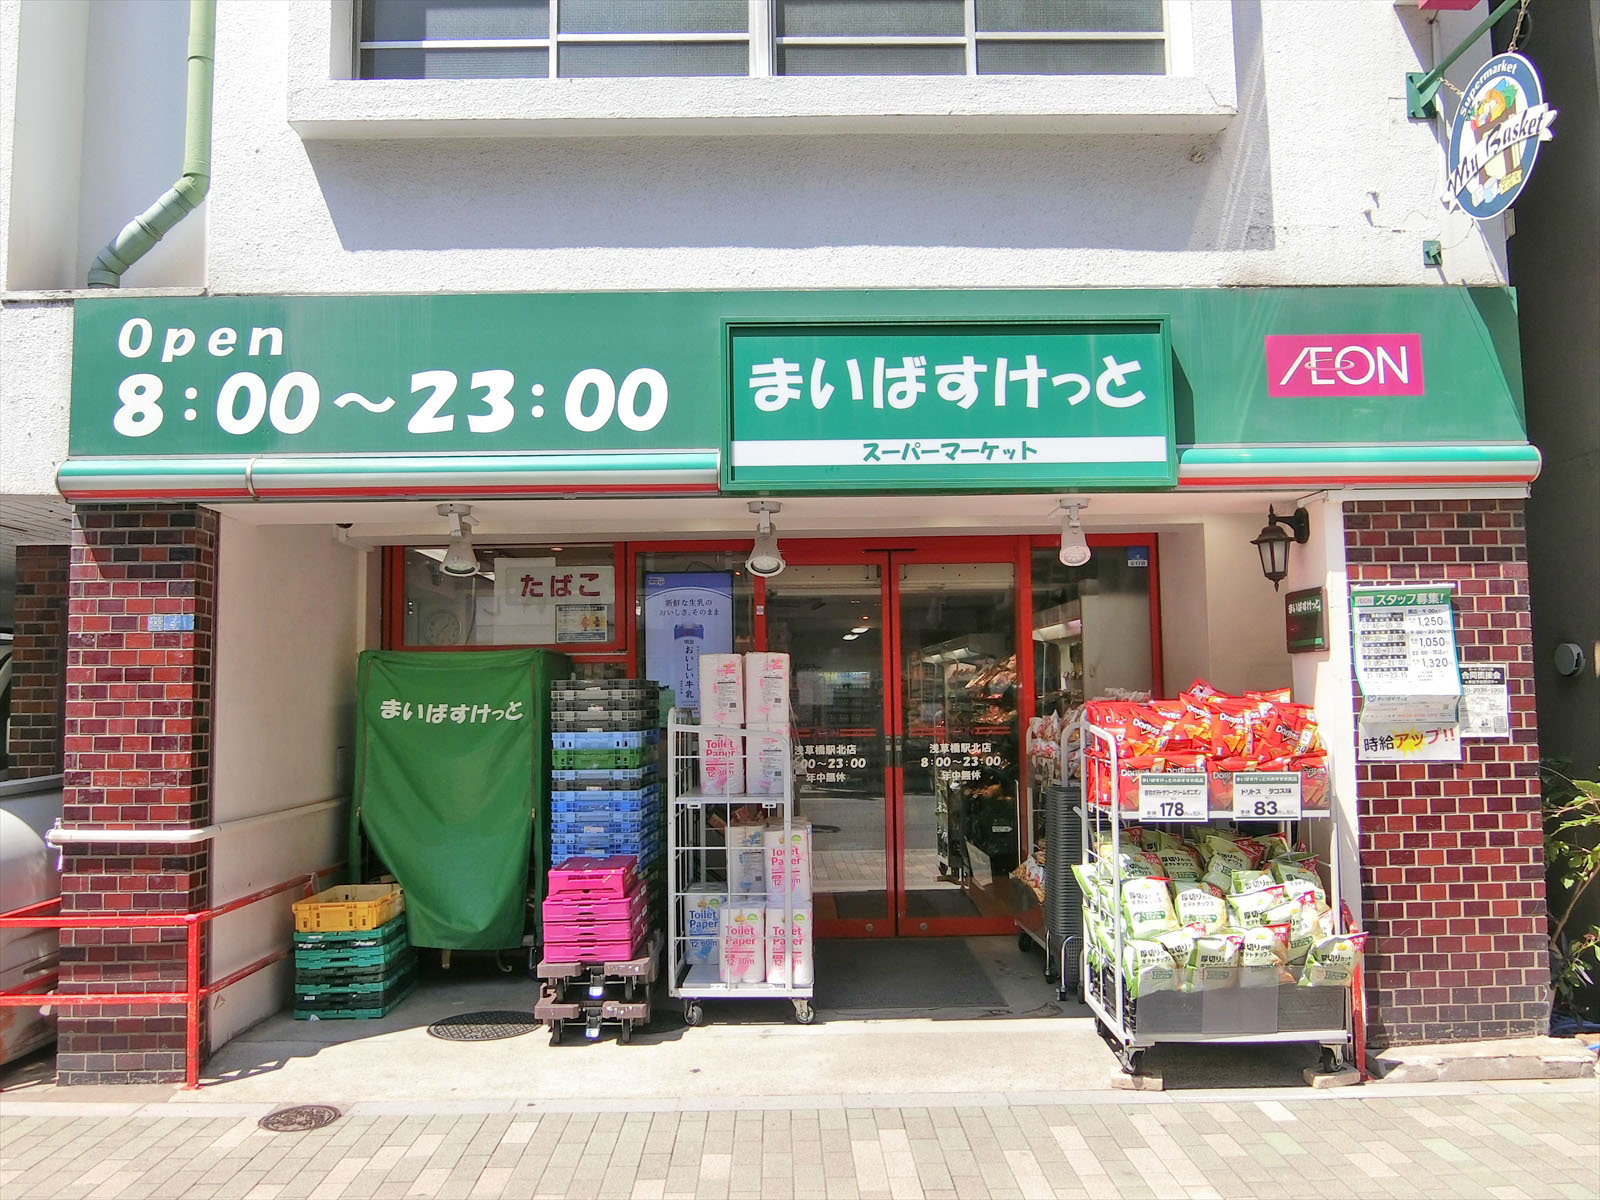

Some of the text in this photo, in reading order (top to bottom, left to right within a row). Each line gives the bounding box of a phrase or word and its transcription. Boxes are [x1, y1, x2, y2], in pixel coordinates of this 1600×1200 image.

[1448, 153, 1480, 199] My
[117, 317, 284, 363] Open
[748, 354, 1146, 412] まいばすけっと
[863, 440, 1038, 462] スーパーマーケット
[520, 572, 601, 598] たばこ
[685, 645, 695, 699] おいしい牛乳
[380, 698, 524, 724] まいばすけっと
[1132, 717, 1160, 736] Doritos
[794, 744, 857, 756] 浅草橋駅北店
[929, 742, 992, 754] 浅草橋駅北店
[806, 771, 846, 783] 年中無休
[940, 769, 981, 781] 年中無休
[1159, 802, 1185, 817] 178
[1254, 801, 1278, 816] 83
[771, 857, 801, 866] Paer
[689, 910, 717, 920] Toilet
[689, 919, 719, 930] Paper
[725, 925, 755, 935] Toilet
[772, 938, 804, 946] Paer
